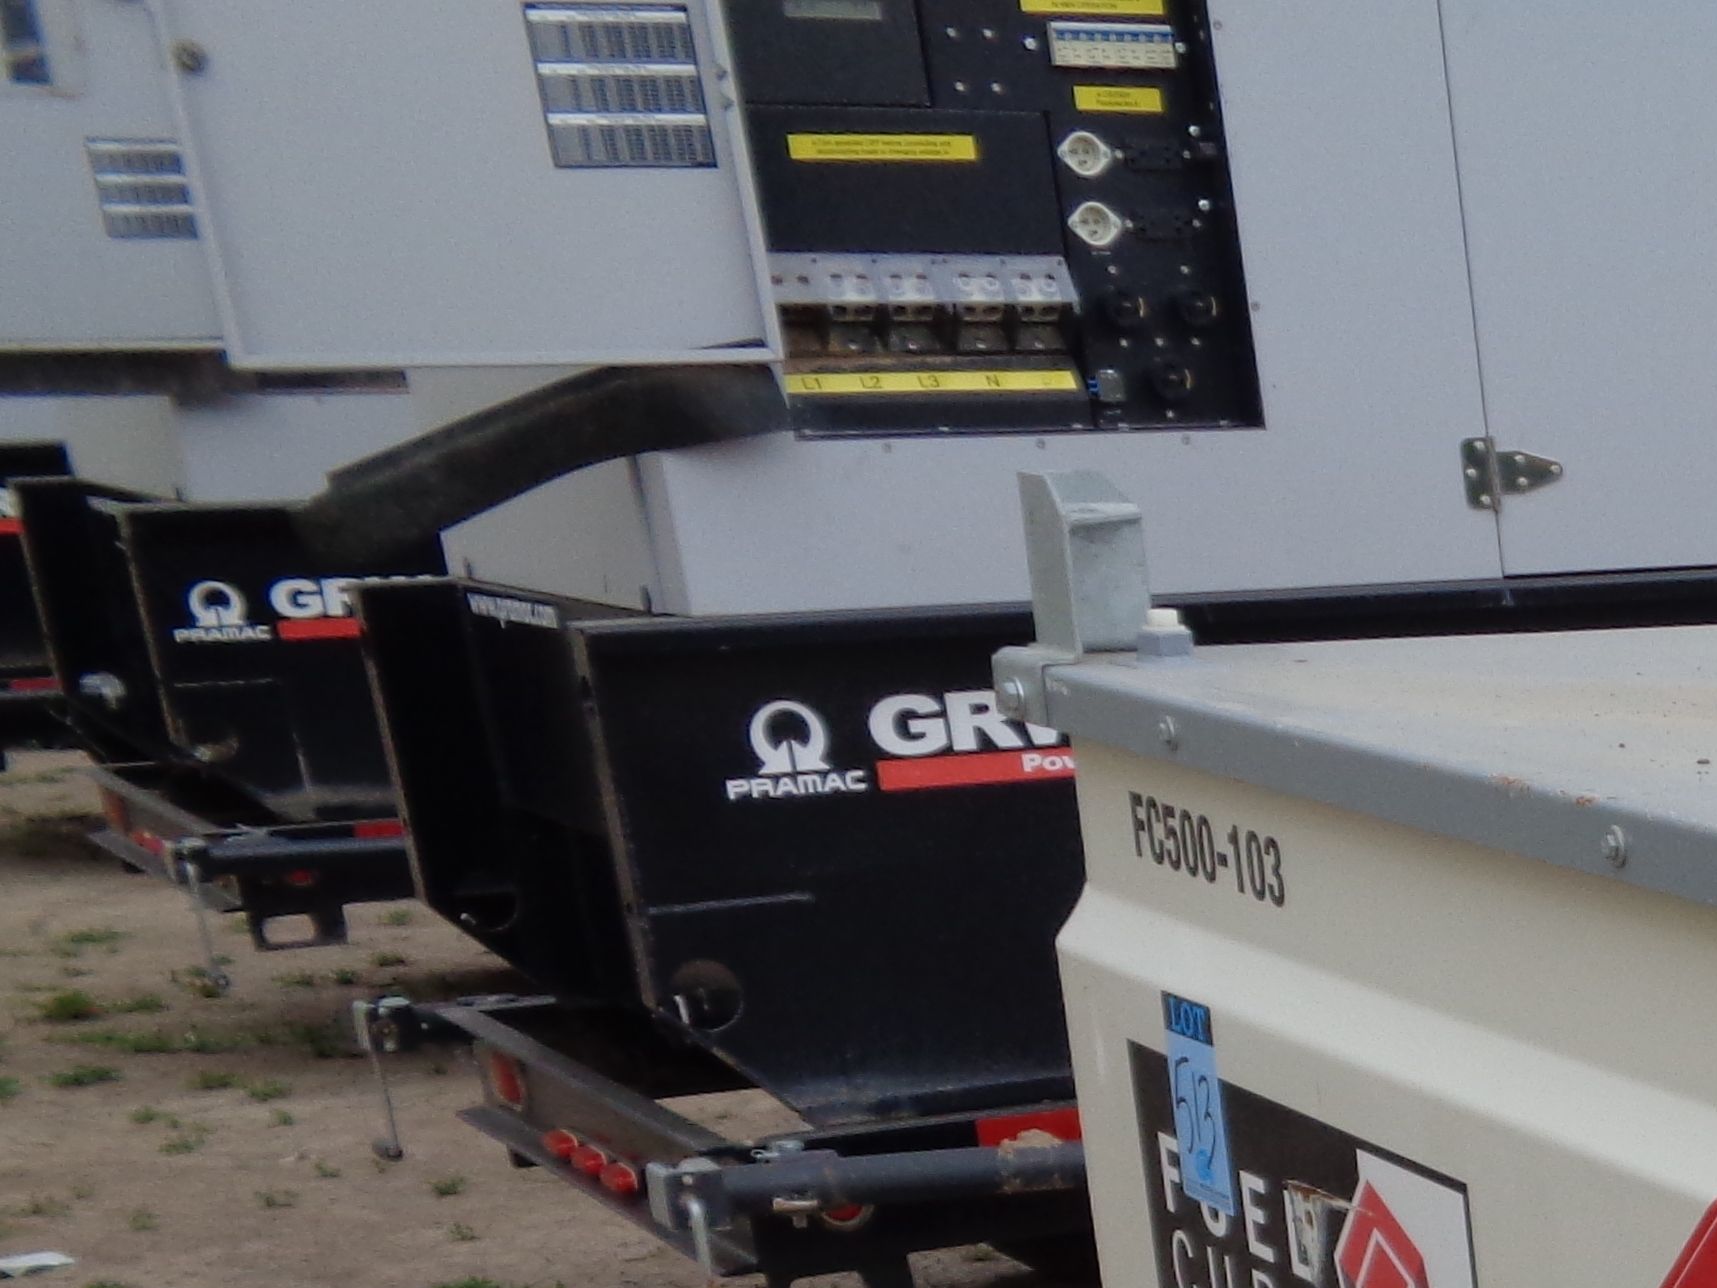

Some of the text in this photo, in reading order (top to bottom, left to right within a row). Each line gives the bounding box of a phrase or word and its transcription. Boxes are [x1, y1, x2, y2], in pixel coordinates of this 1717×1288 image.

[802, 375, 1001, 390] L1 L2 L3 N
[173, 625, 271, 643] PRAMAC
[868, 689, 1060, 755] GR
[725, 770, 869, 800] PRAMAC
[1128, 790, 1285, 908] FC500-103
[1169, 997, 1207, 1041] LOT
[1174, 1055, 1216, 1171] 513
[1157, 1131, 1321, 1283] FEL
